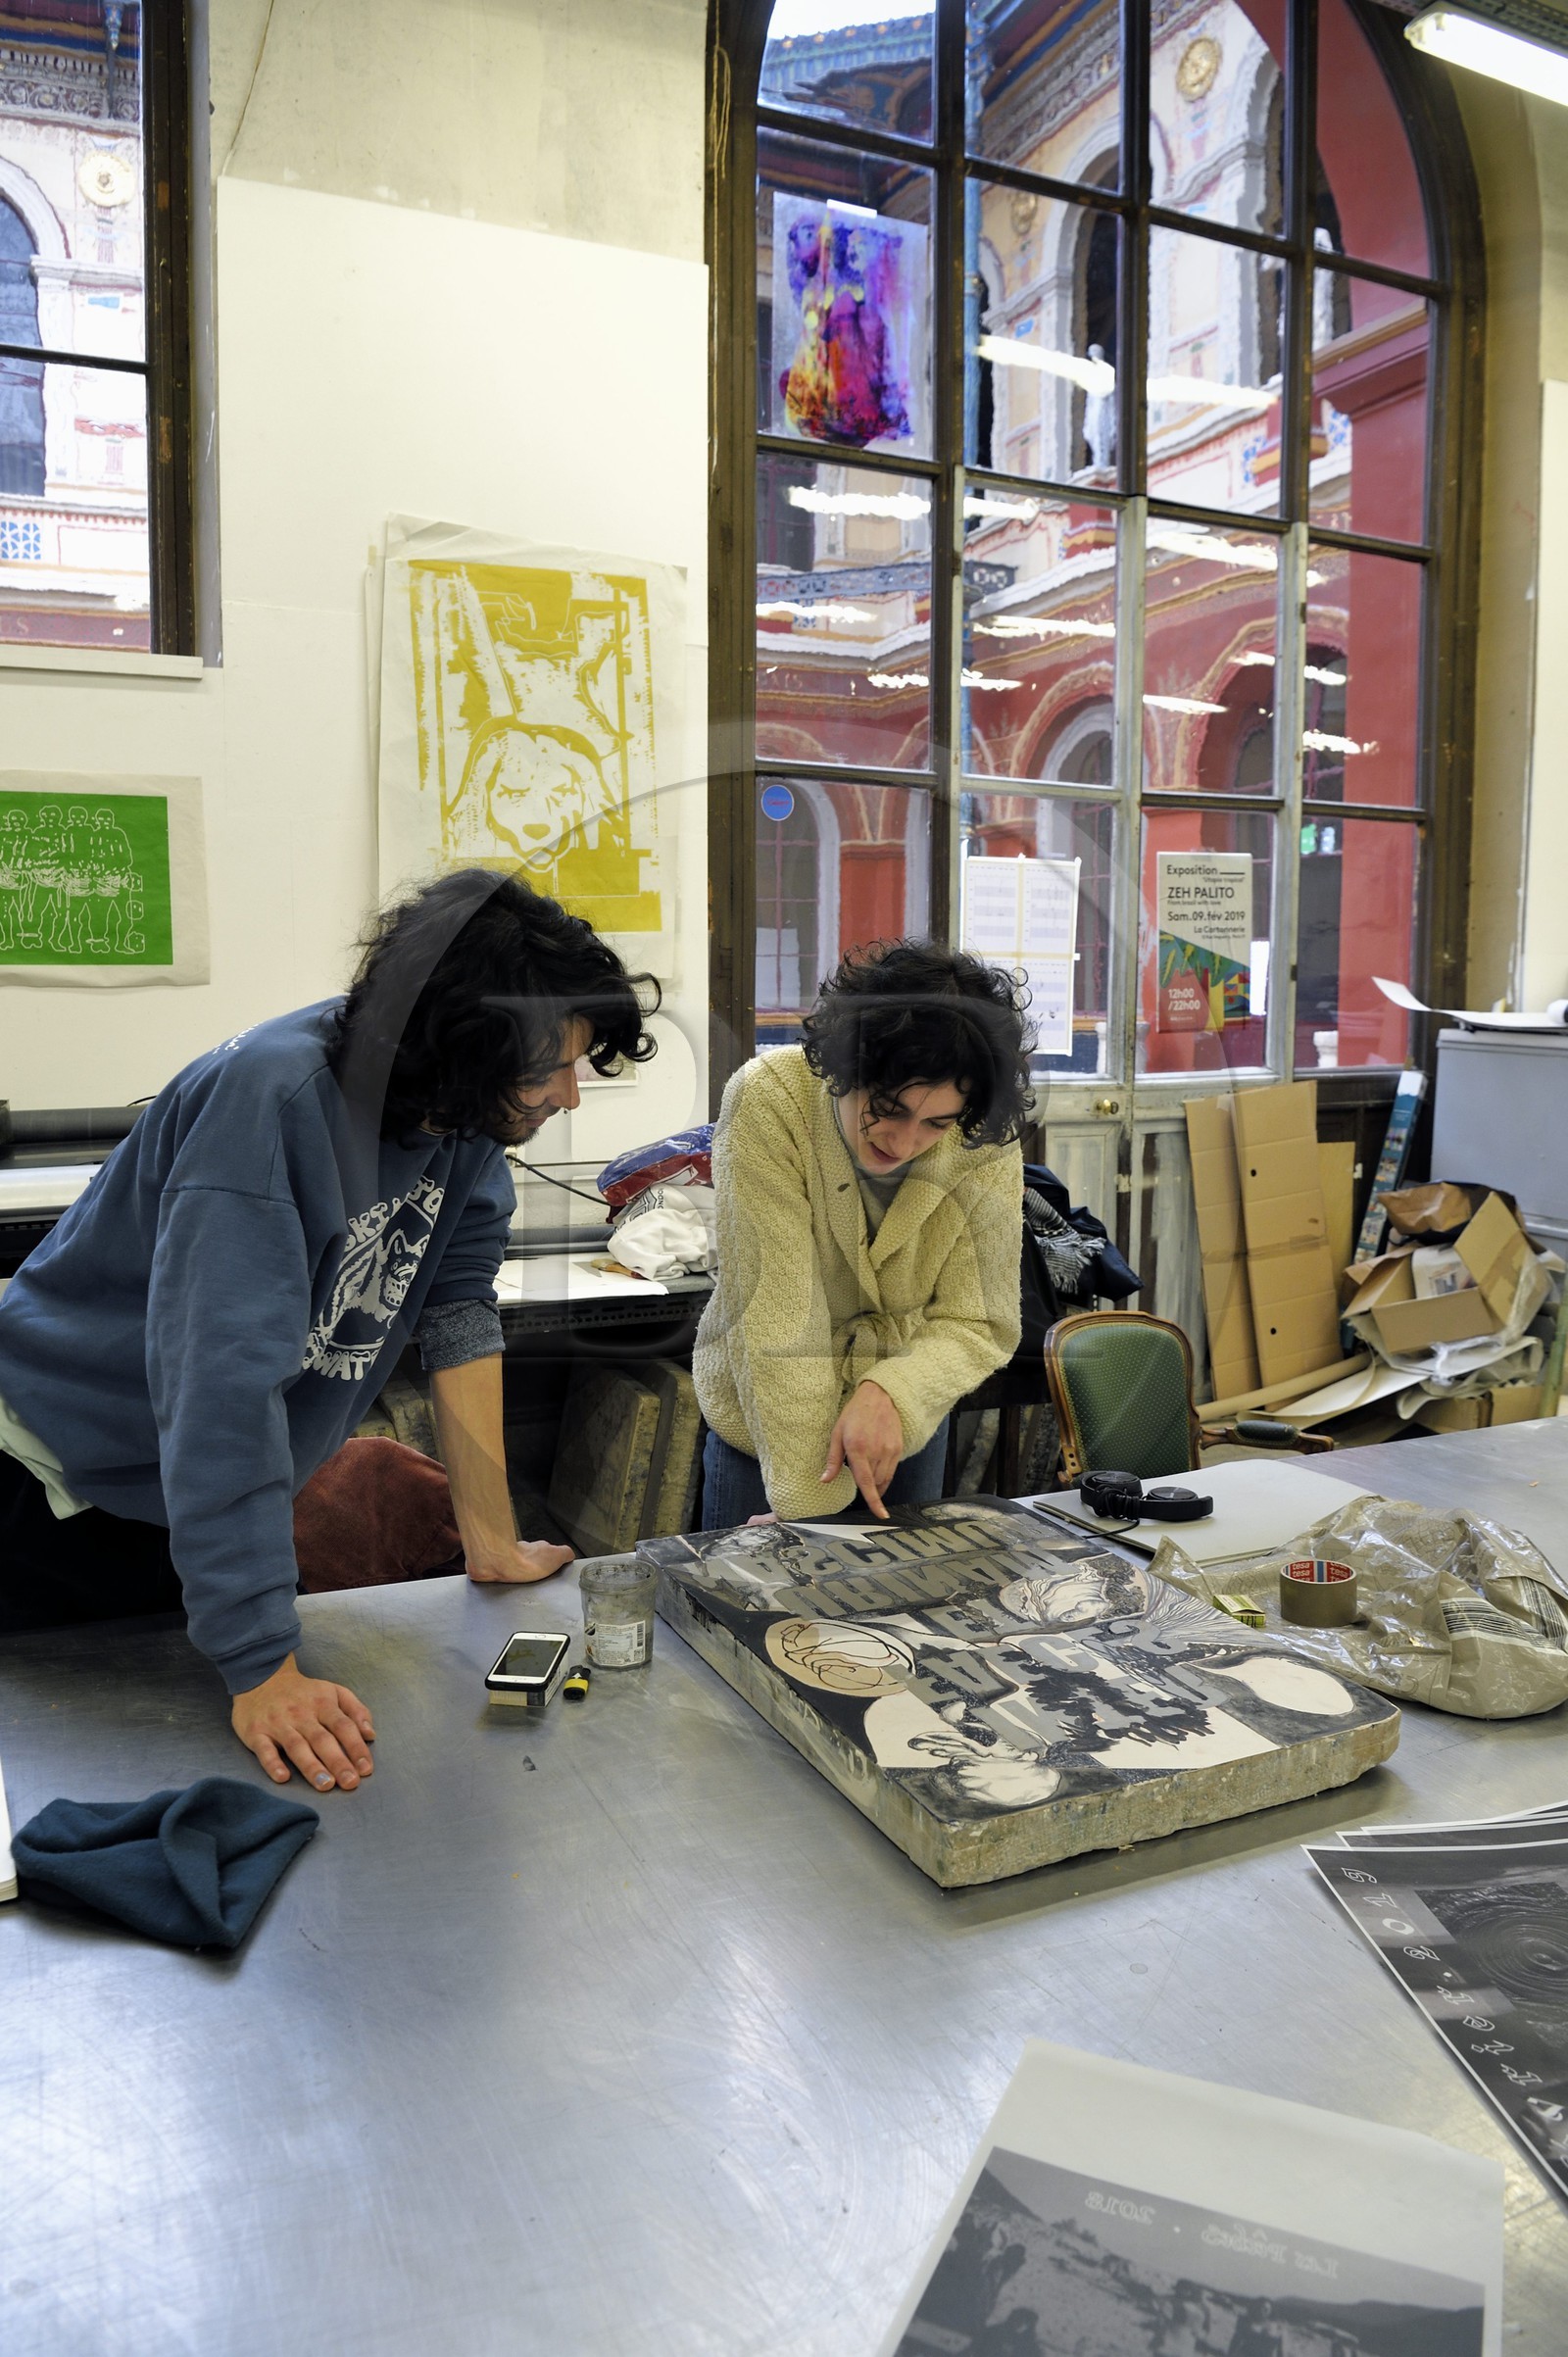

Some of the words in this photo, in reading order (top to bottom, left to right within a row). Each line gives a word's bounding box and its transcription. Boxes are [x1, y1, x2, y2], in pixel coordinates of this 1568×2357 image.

[1166, 864, 1218, 878] Exposition
[1167, 887, 1191, 899] ZEH
[1194, 887, 1235, 899] PALITO
[1224, 910, 1246, 921] 2019
[1168, 988, 1195, 999] 12h00
[1330, 1567, 1348, 1578] tesa
